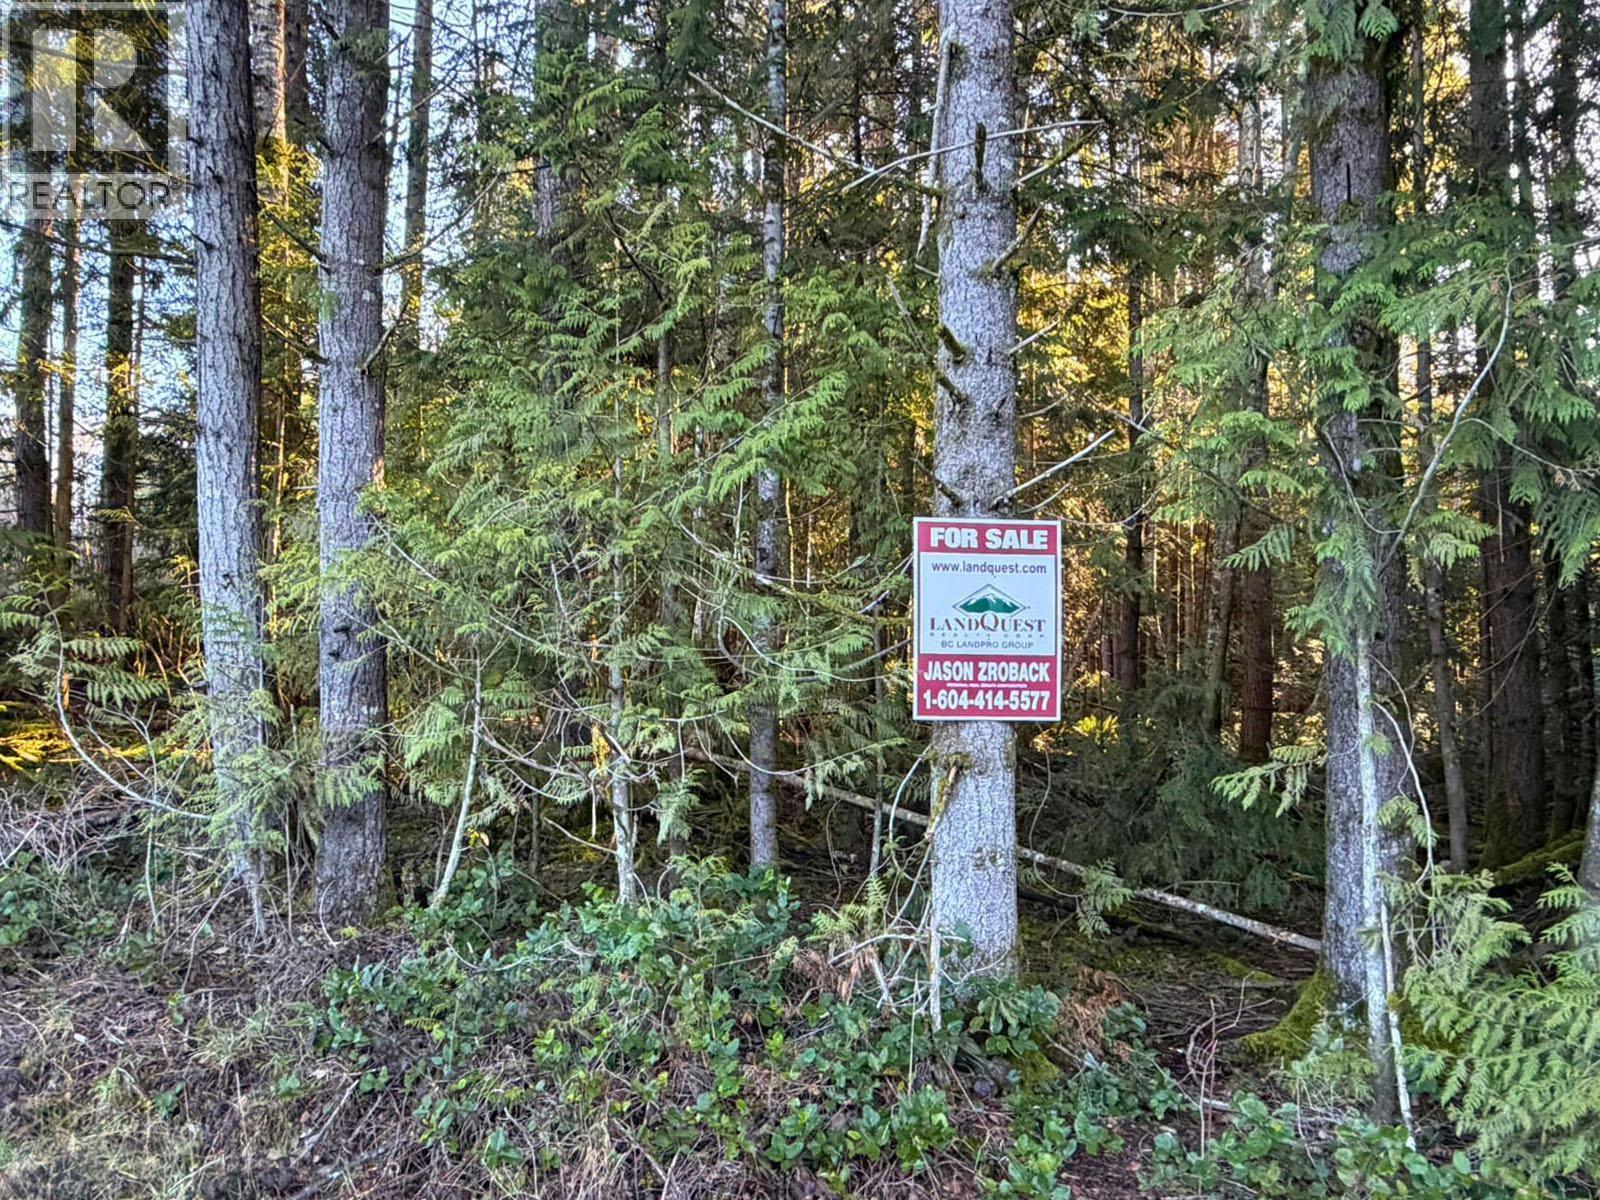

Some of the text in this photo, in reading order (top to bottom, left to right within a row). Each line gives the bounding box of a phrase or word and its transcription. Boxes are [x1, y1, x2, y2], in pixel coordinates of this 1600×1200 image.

[930, 527, 1048, 550] FOR SALE
[931, 561, 1047, 575] www.landquest.com
[941, 640, 1034, 649] BC LANDPRO GROUP
[924, 661, 1050, 682] JASON ZROBACK
[923, 689, 1051, 710] 1-604-414-5577
